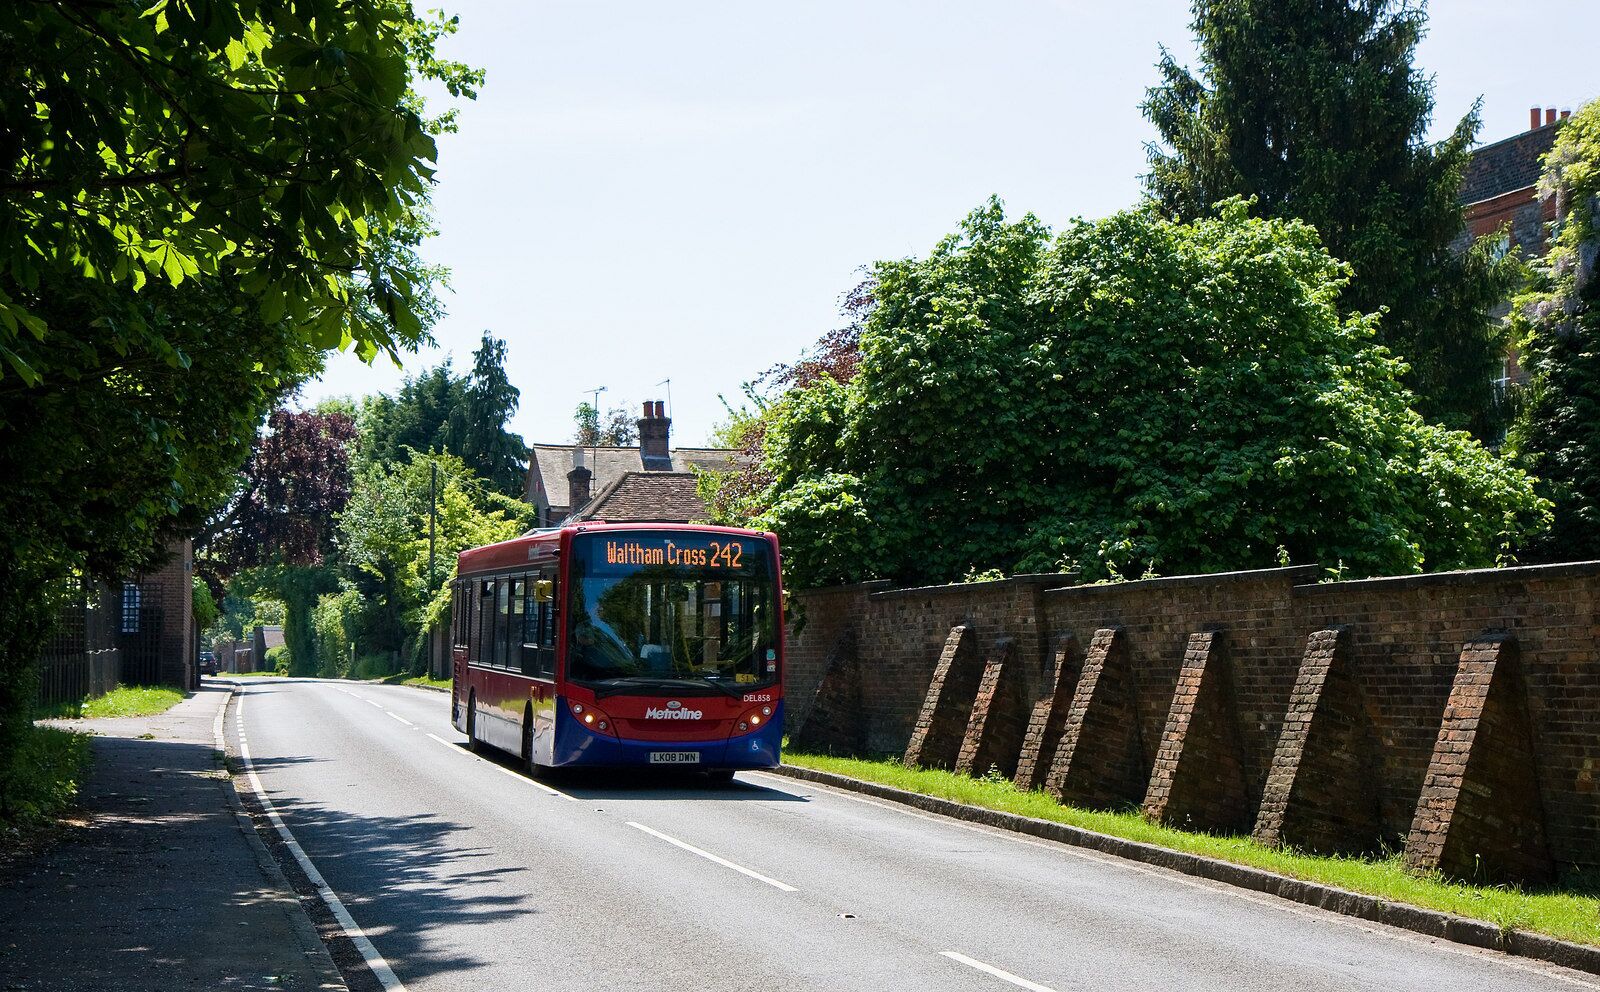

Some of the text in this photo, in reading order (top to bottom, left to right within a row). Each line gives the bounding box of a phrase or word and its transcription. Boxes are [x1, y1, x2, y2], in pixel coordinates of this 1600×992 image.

[607, 541, 742, 567] Waltham Cross 242
[743, 694, 771, 702] DEL858
[645, 706, 703, 720] Metroline
[653, 753, 696, 762] LK08 DWN
